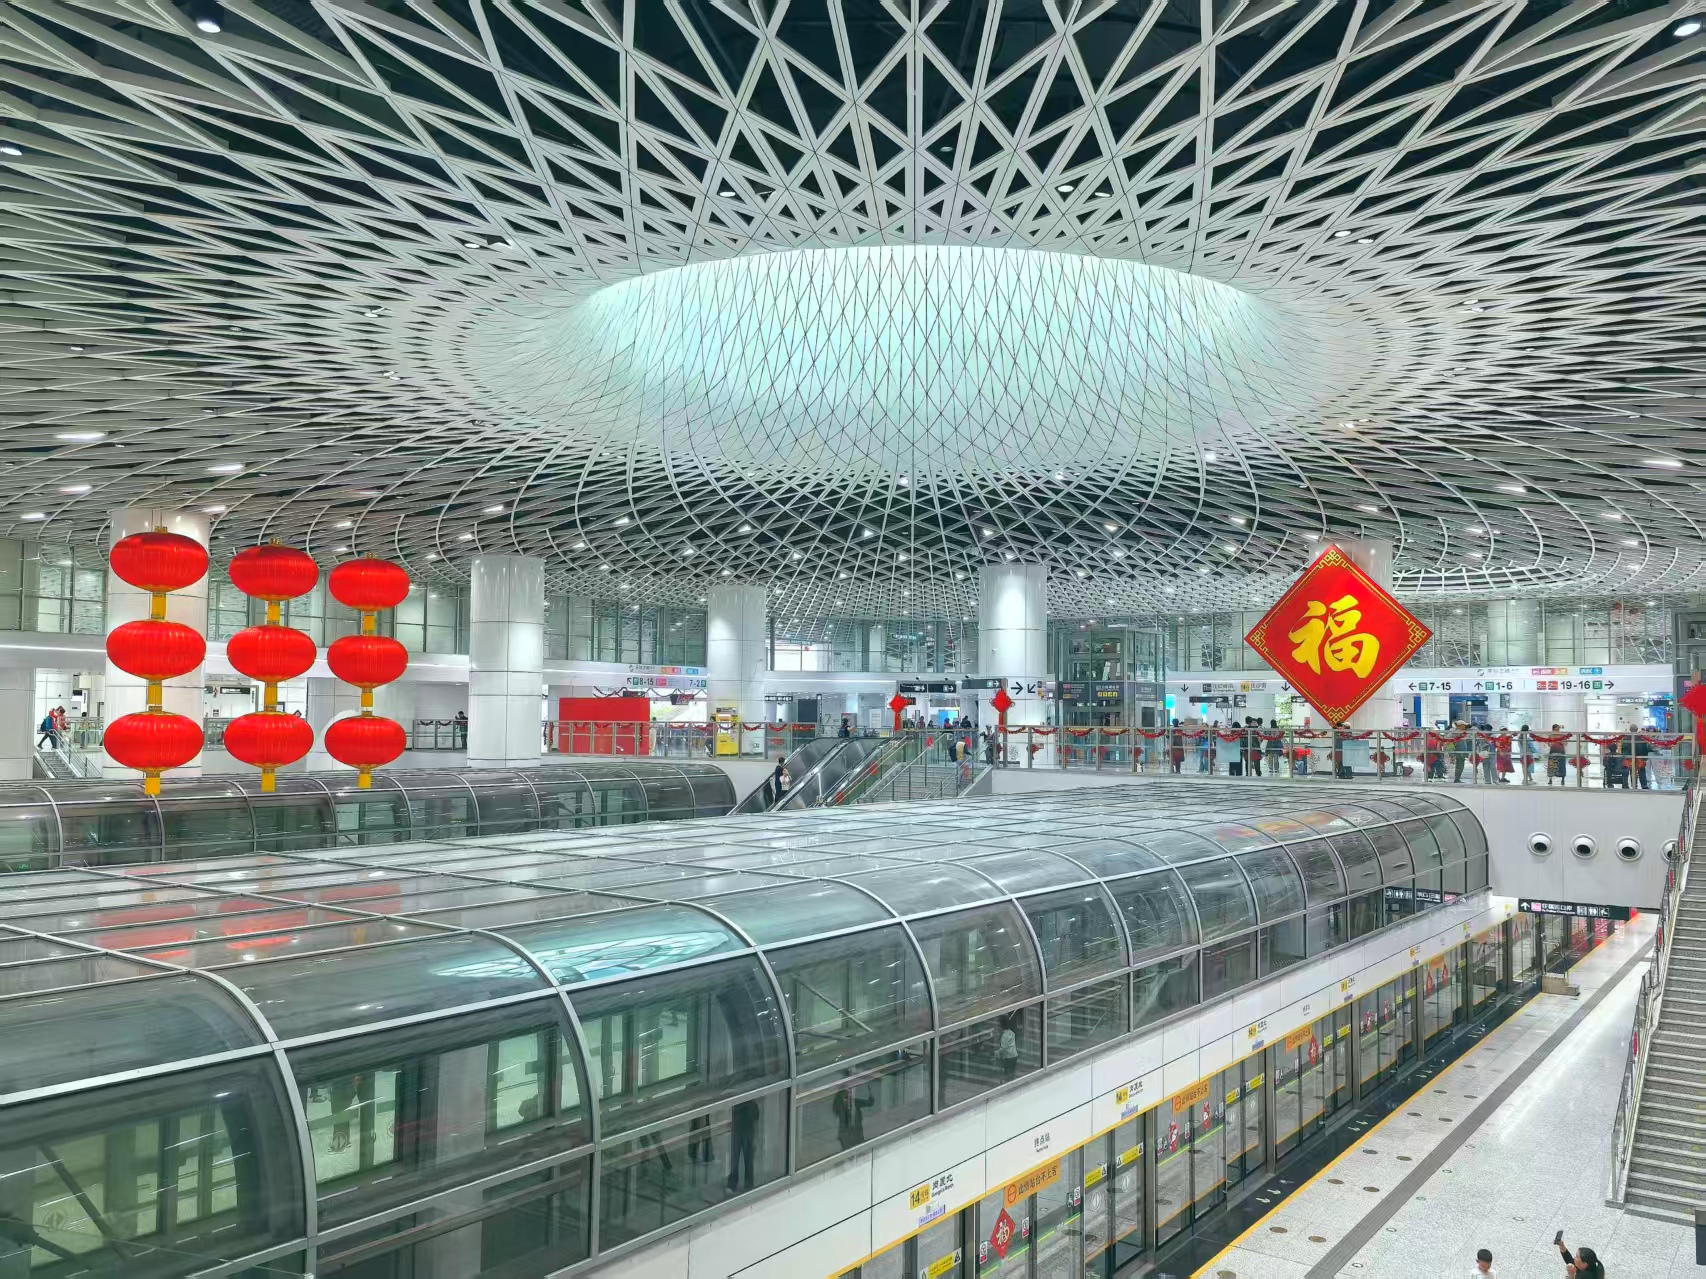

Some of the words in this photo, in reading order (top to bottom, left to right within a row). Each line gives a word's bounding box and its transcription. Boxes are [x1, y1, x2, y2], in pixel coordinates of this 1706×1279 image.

[1288, 594, 1380, 679] 福
[1429, 682, 1451, 690] 7-15
[1496, 681, 1513, 690] 1-6
[1560, 680, 1591, 690] 19-16
[932, 1173, 954, 1190] 岗厦北
[995, 1219, 1010, 1245] 福
